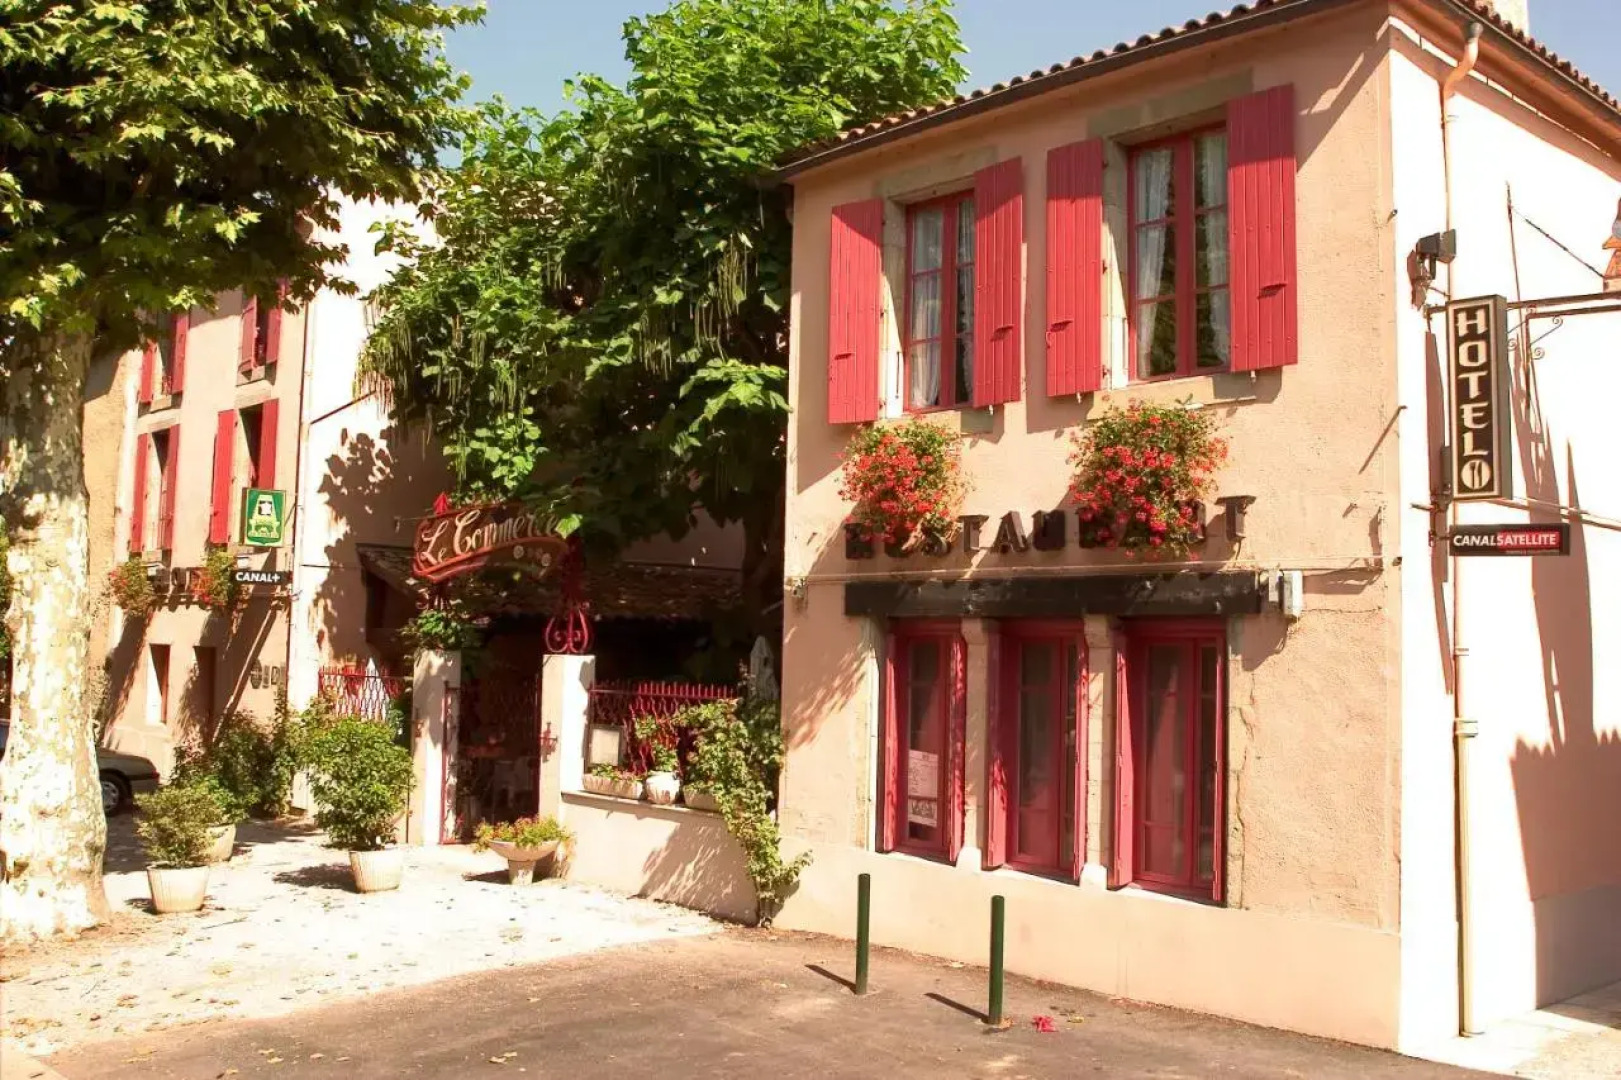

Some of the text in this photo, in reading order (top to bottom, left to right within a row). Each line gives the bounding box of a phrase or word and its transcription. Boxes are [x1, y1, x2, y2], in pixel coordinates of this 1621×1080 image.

[1456, 309, 1489, 457] HOTEL
[420, 519, 449, 566] Le
[235, 571, 281, 583] CANAL+
